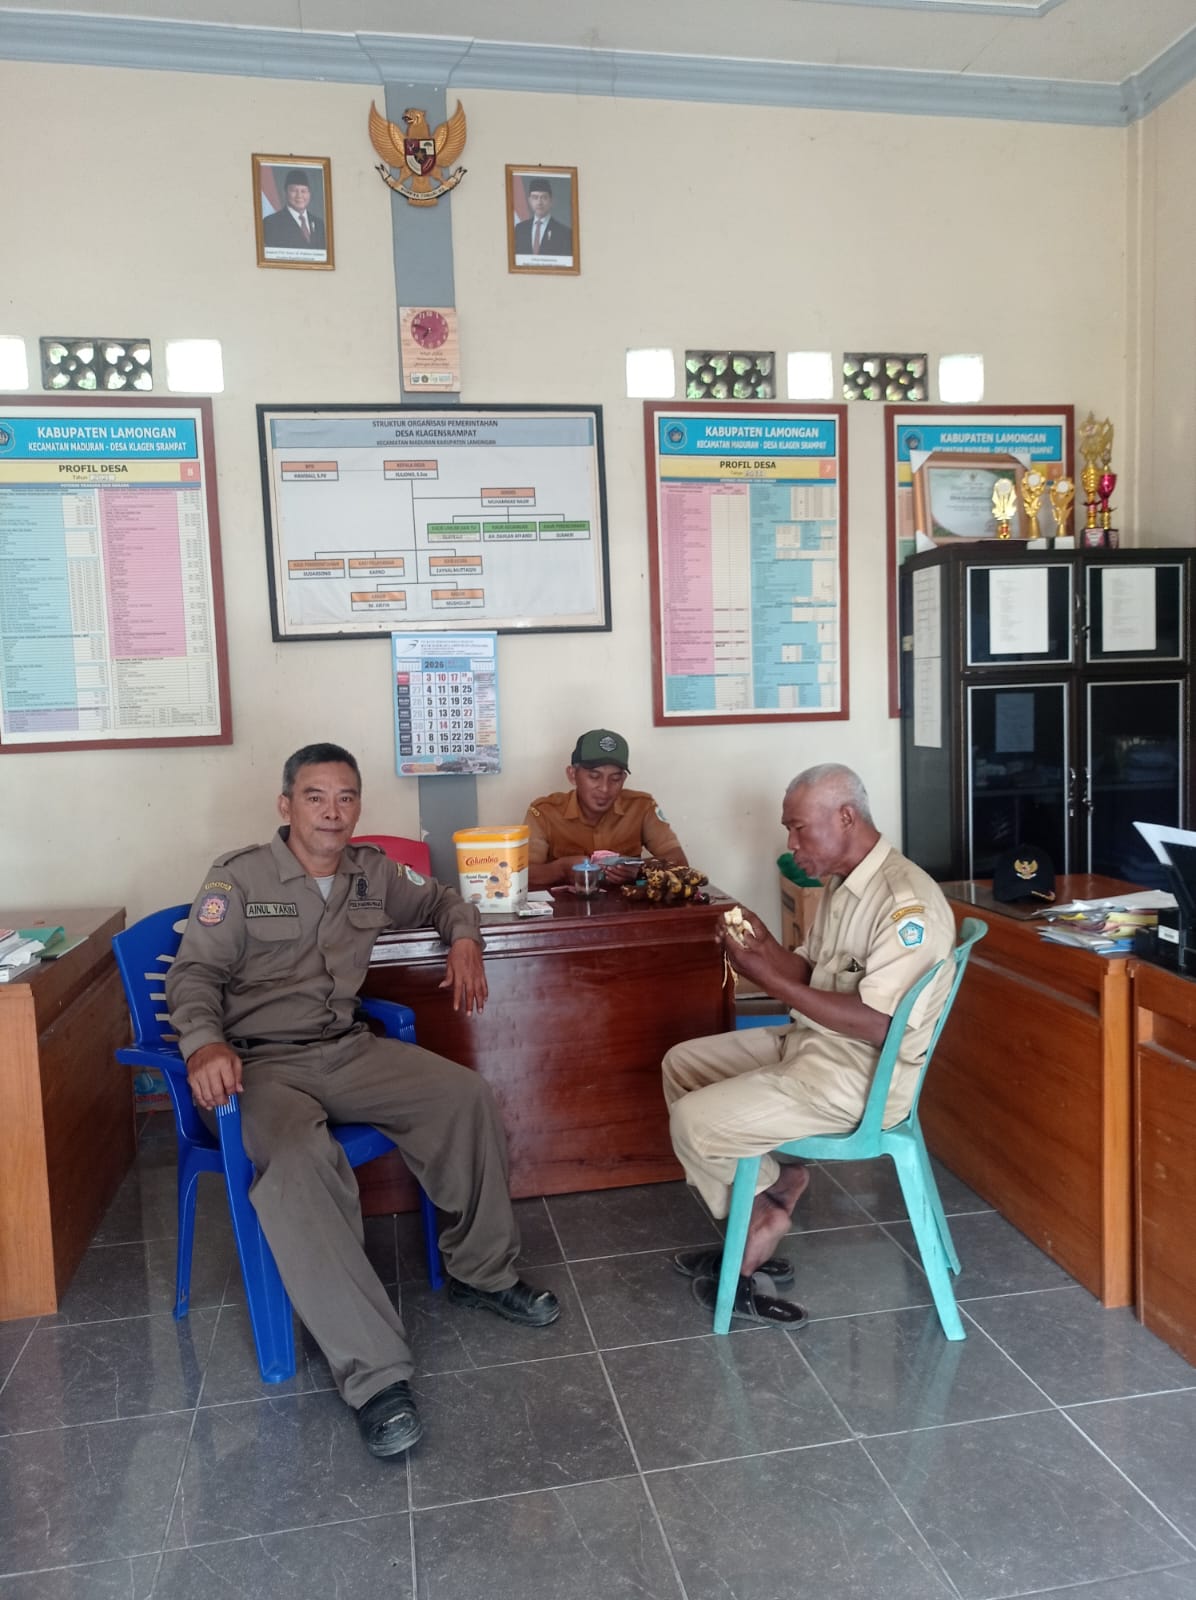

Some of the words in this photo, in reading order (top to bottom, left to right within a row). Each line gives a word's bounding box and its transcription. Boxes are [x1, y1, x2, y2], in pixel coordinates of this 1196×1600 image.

[372, 420, 406, 428] STRUKTUR
[407, 420, 447, 428] ORGANISASI
[37, 427, 108, 439] KABUPATEN
[111, 427, 176, 439] LAMONGAN
[395, 430, 414, 438] DESA
[415, 430, 477, 438] KLAGENSRAMPAT
[705, 426, 763, 437] KABUPATEN
[764, 427, 819, 437] LAMONGAN
[940, 433, 994, 443] KABUPATEN
[995, 433, 1047, 443] LAMONGAN
[28, 442, 70, 451] KECAMATAN
[71, 442, 104, 451] MADURAN
[110, 442, 128, 451] DESA
[129, 442, 155, 451] KLAGEN
[155, 442, 186, 451] SRAMPAT
[696, 440, 730, 449] KECAMATAN
[763, 441, 777, 449] DESA
[58, 464, 98, 473] PROFIL
[100, 464, 128, 473] DESA
[719, 460, 751, 469] PROFIL
[754, 460, 777, 469] DESA
[426, 673, 432, 682] 3
[438, 673, 446, 682] 10
[451, 673, 458, 682] 17
[426, 686, 432, 694] 4
[438, 686, 446, 694] 11
[450, 685, 459, 694] 18
[462, 685, 472, 693] 25
[427, 697, 433, 706] 5
[439, 697, 447, 706] 12
[451, 697, 460, 705] 19
[462, 697, 472, 705] 26
[427, 709, 433, 717] 6
[439, 709, 448, 717] 13
[450, 709, 460, 717] 20
[463, 708, 473, 717] 27
[428, 721, 434, 729] 7
[439, 721, 448, 729] 14
[451, 720, 461, 729] 21
[463, 720, 474, 728] 28
[416, 733, 421, 742] 1
[428, 733, 434, 741] 8
[440, 733, 449, 741] 15
[451, 733, 461, 741] 22
[416, 745, 422, 754] 2
[429, 745, 435, 753] 9
[440, 745, 449, 754] 16
[452, 745, 462, 753] 23
[464, 744, 475, 753] 30
[248, 904, 271, 915] AINUL
[273, 904, 296, 914] YAKIN
